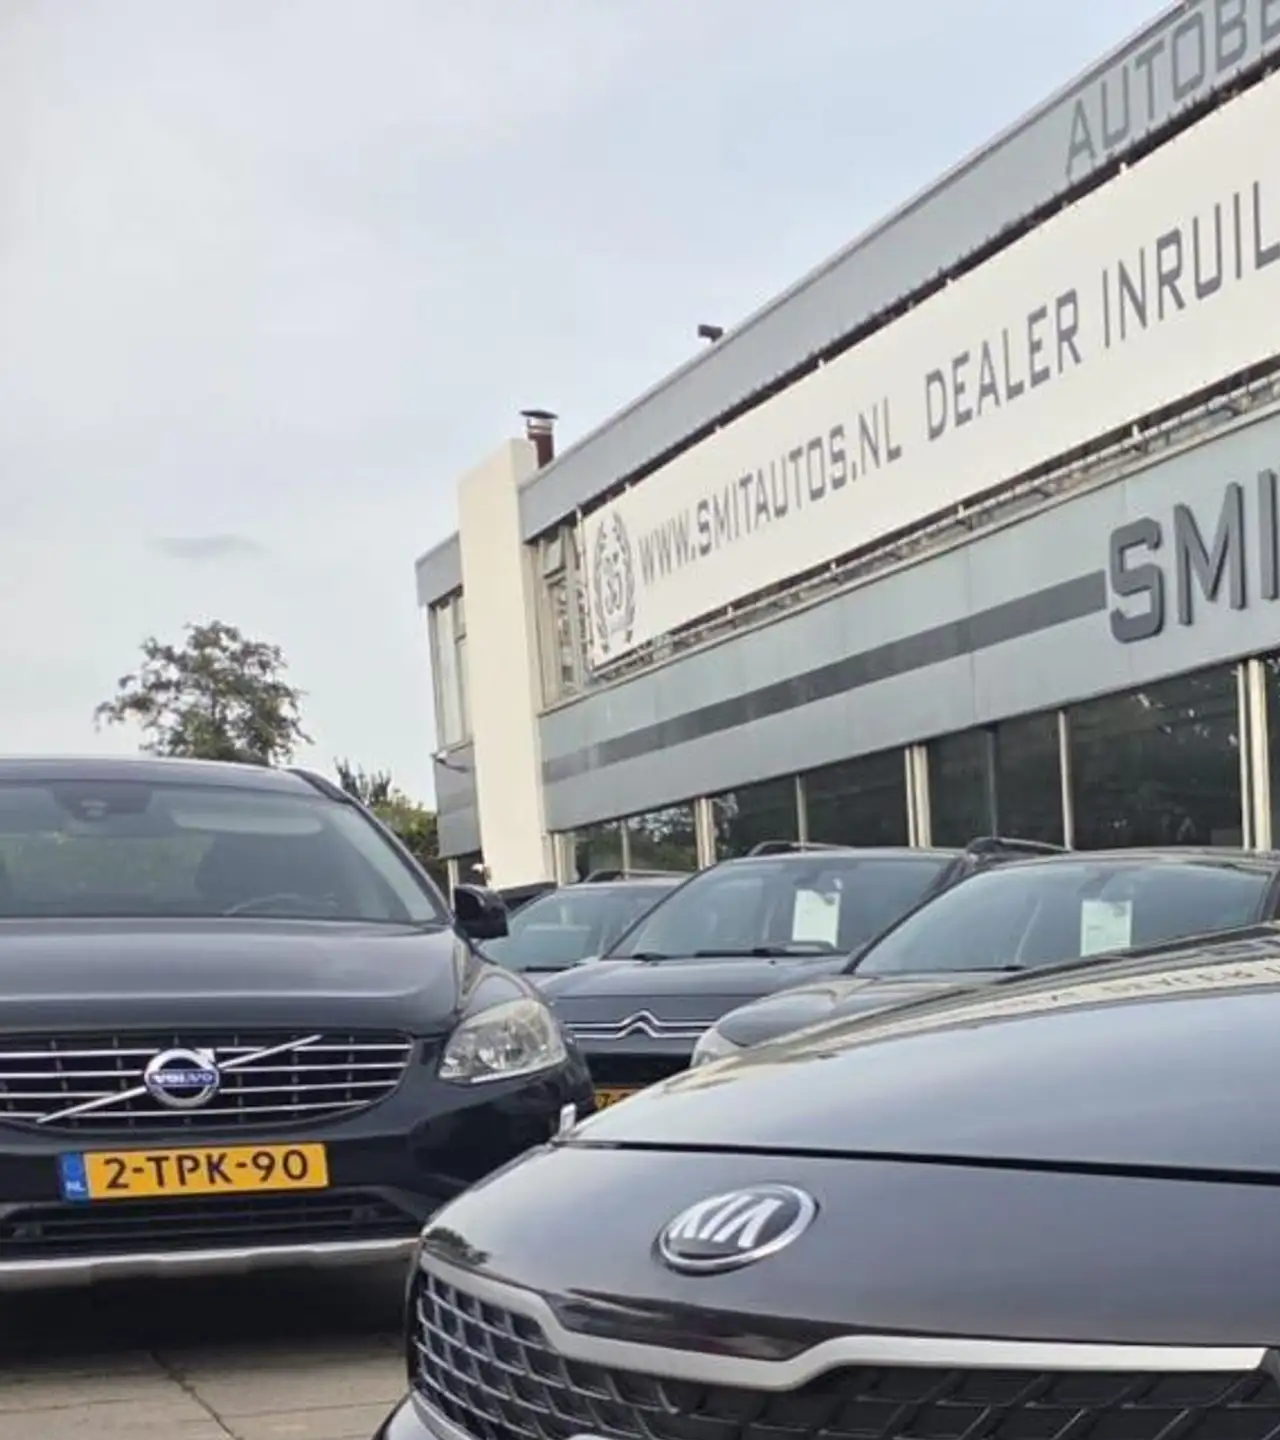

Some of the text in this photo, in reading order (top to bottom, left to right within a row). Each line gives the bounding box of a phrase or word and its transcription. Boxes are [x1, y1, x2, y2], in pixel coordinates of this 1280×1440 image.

[637, 397, 902, 586] WWW.SMITAUTOS.NL
[925, 288, 1082, 442] DEALER
[151, 1071, 215, 1085] VOLVO
[103, 1149, 308, 1190] 2-TPK-90
[669, 1194, 785, 1249] KIA
